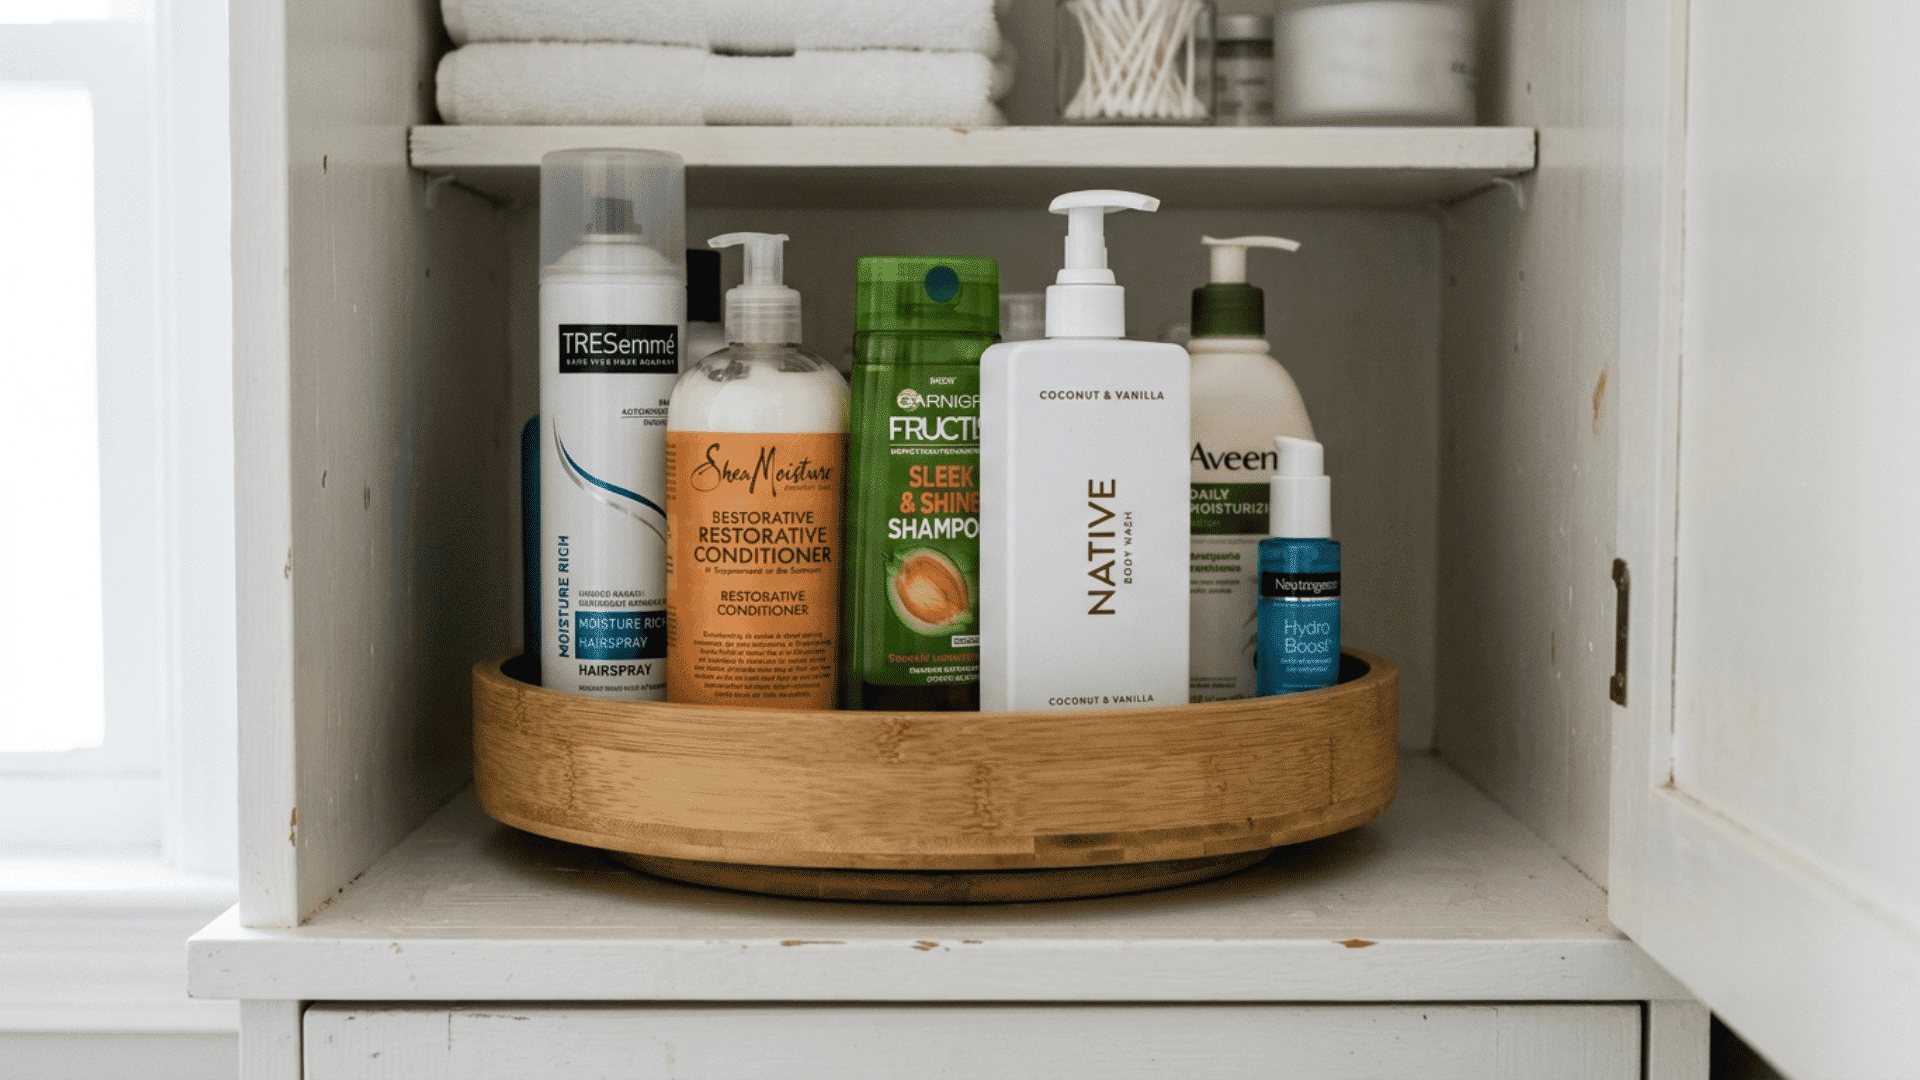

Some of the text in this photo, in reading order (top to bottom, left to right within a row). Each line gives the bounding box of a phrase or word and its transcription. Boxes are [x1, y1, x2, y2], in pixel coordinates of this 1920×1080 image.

[562, 332, 675, 354] TRESemmé
[1039, 390, 1165, 400] COCONUT & VANILLA
[890, 416, 980, 441] FRUCTI
[909, 465, 974, 488] SLEEK
[900, 491, 980, 514] & SHINE
[712, 511, 815, 525] BESTORATIVE
[699, 527, 828, 544] RESTORATIVE
[694, 546, 832, 565] CONDITIONER
[1087, 479, 1116, 615] NATIVE
[1124, 512, 1133, 585] BODY WASH
[558, 535, 570, 658] MOISTURE RICH
[720, 590, 806, 602] RESTORATIVE
[716, 604, 809, 616] CONDITIONER
[579, 618, 641, 630] MOISTURE
[1285, 619, 1330, 638] Hydro
[579, 636, 649, 649] HAIRSPRAY
[579, 664, 652, 676] HAIRSPRAY
[1048, 696, 1100, 706] COCONUT
[1112, 694, 1155, 703] VANILLA
